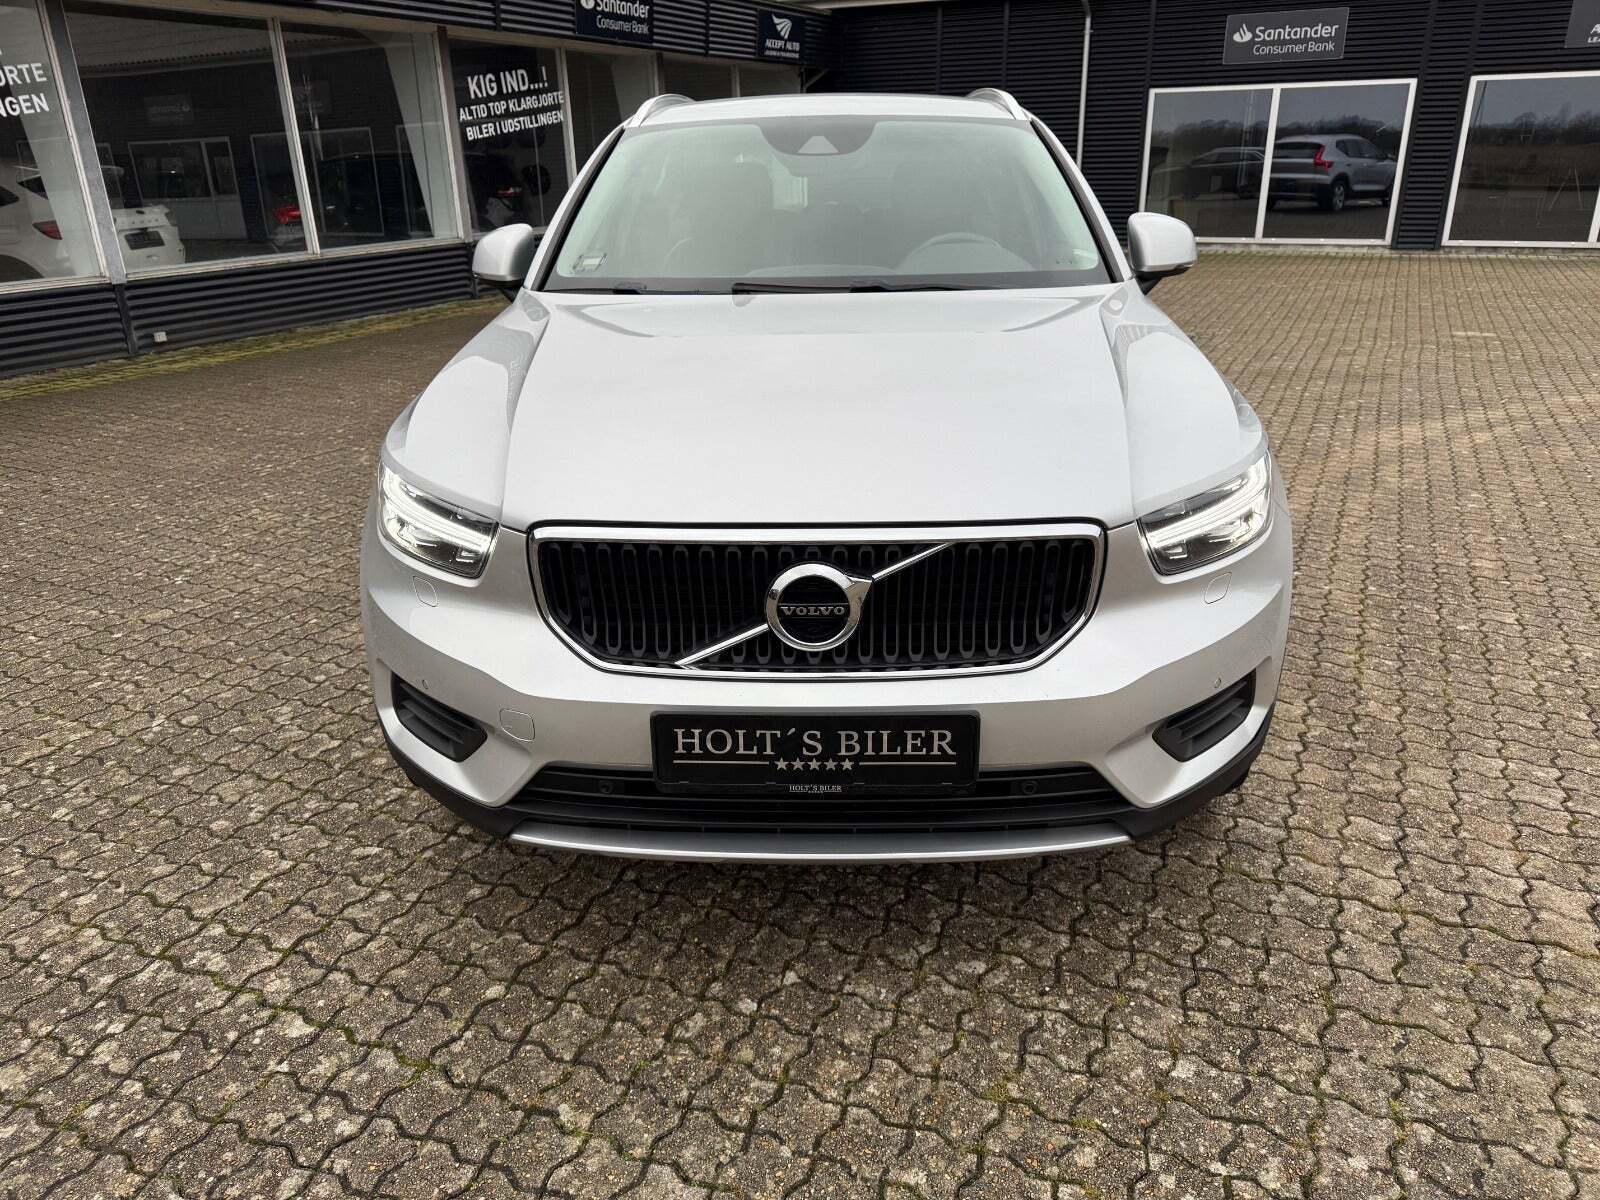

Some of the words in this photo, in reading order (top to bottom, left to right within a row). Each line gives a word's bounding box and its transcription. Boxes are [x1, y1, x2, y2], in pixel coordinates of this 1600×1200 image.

[596, 0, 649, 18] Santander
[596, 15, 632, 32] Consumer
[632, 21, 649, 34] Bank
[1255, 23, 1339, 41] Santander
[1253, 44, 1306, 55] Consumer
[1308, 41, 1335, 52] Bank
[467, 73, 498, 99] KIG
[500, 66, 548, 94] IND...!
[460, 106, 488, 122] ALTID
[488, 100, 507, 116] TOP
[508, 91, 564, 113] KLARGJORTE
[466, 122, 496, 141] BILER
[501, 110, 564, 134] UDSTILLINGEN
[780, 606, 845, 616] VOLVO
[837, 730, 957, 756] BILER
